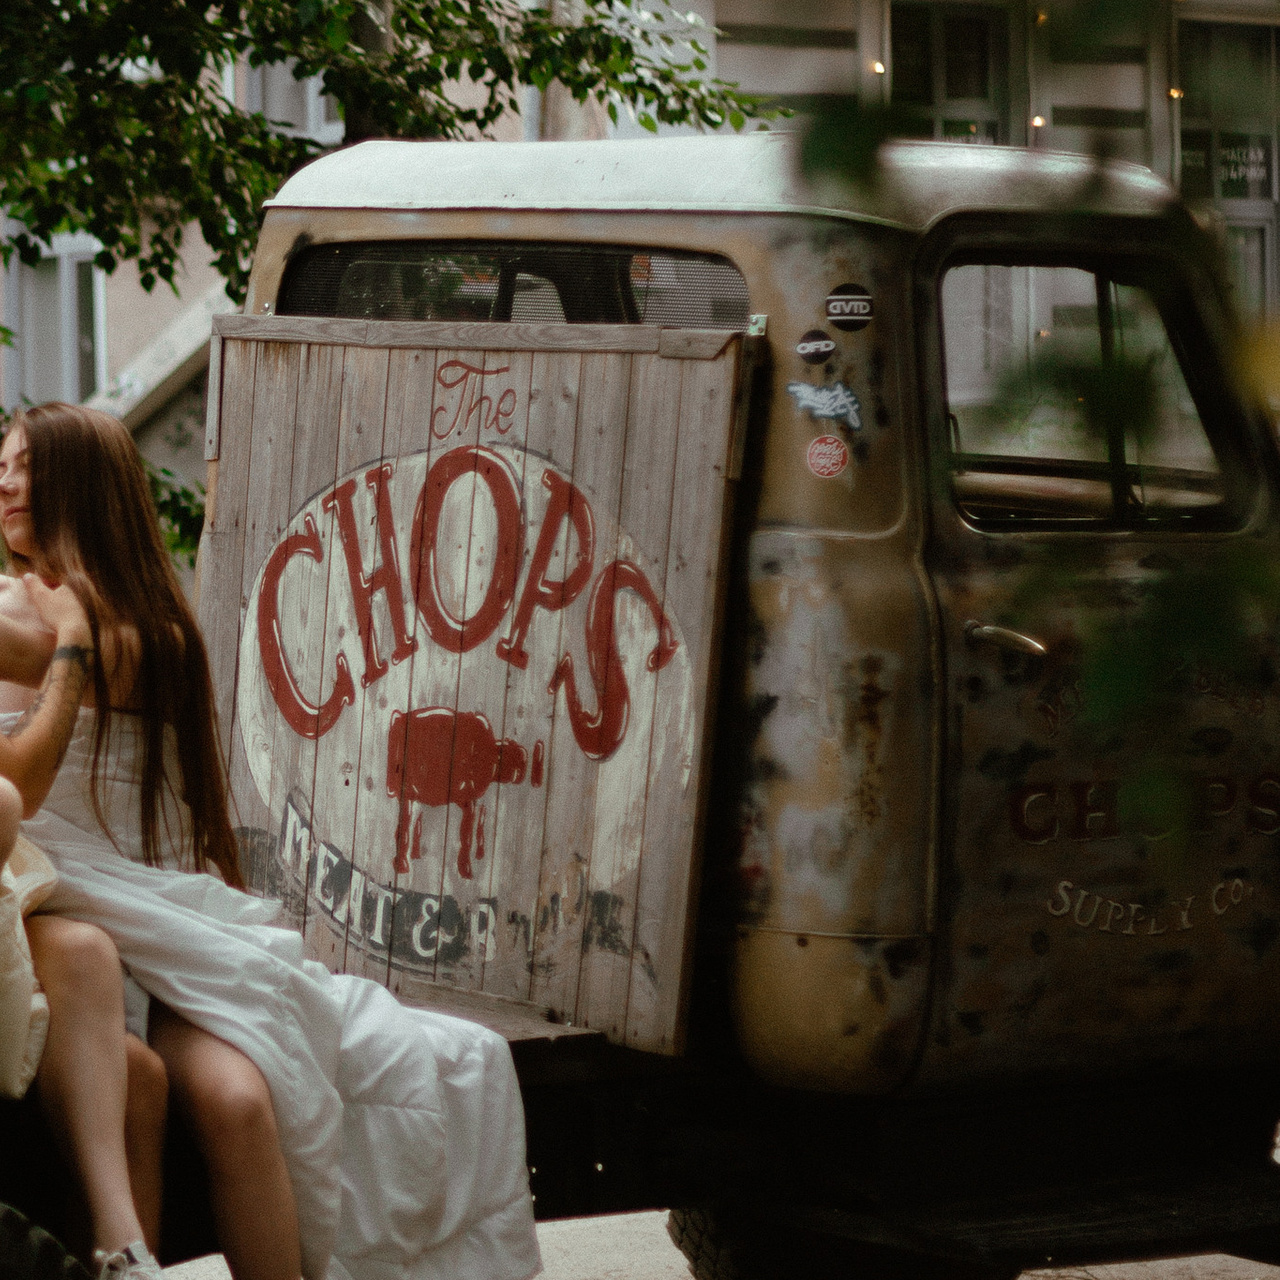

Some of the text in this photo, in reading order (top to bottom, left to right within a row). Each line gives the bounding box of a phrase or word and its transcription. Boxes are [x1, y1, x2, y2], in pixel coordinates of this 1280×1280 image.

[431, 359, 518, 441] The
[257, 444, 680, 762] CHOPS
[1009, 771, 1280, 846] CHPS
[283, 801, 404, 946] MEAT
[412, 898, 458, 958] &
